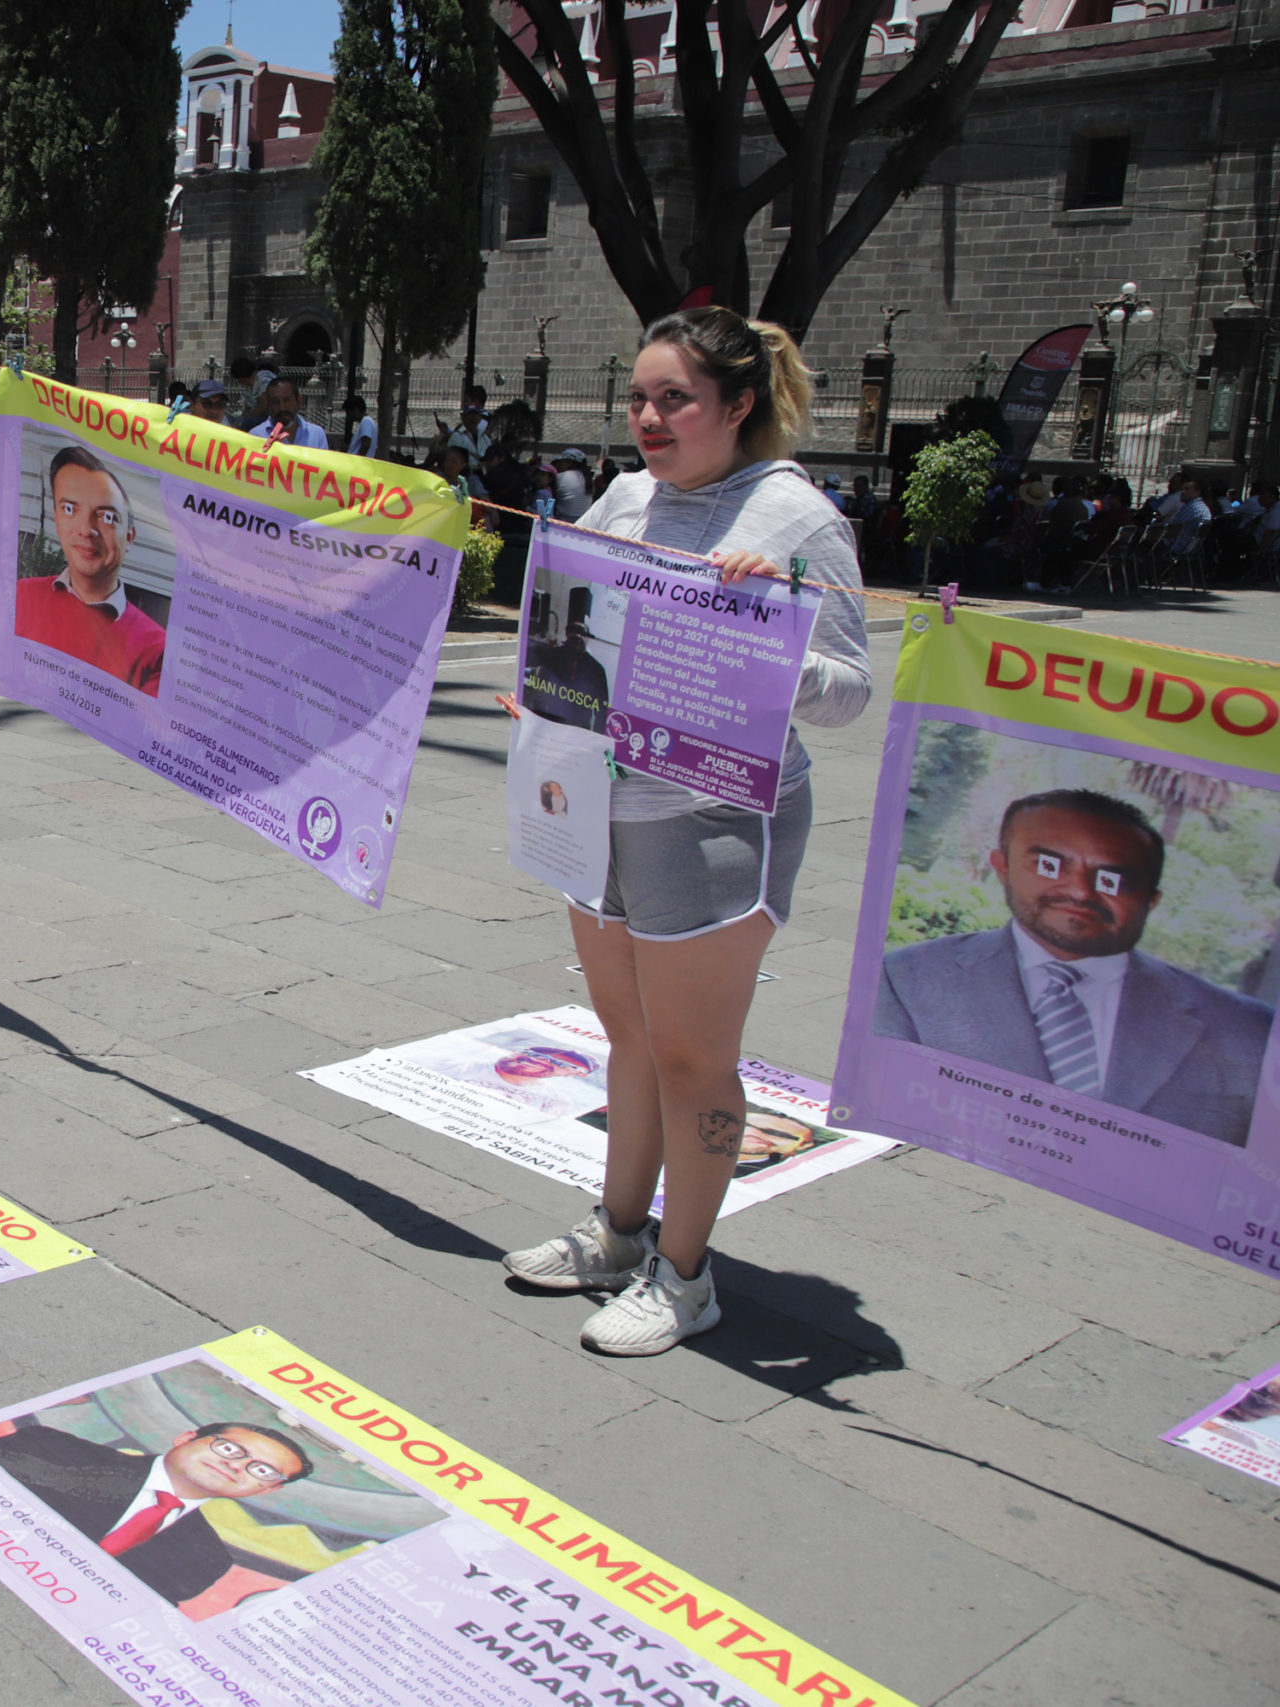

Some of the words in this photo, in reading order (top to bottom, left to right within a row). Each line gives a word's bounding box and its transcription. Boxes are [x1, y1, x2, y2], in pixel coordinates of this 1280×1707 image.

[32, 378, 149, 451] DEUDOR
[158, 428, 413, 521] ALIMENTARIO
[182, 495, 280, 542] AMADITO
[287, 513, 423, 584] ESPINOZA
[426, 556, 443, 580] J.
[607, 545, 653, 565] DEUDOR
[655, 555, 723, 582] ALIMENTARI
[615, 570, 667, 597] JUAN
[671, 584, 739, 617] COSCA
[635, 630, 660, 648] para
[658, 636, 675, 651] no
[674, 640, 706, 661] pagar
[705, 649, 714, 663] y
[637, 614, 654, 631] En
[652, 619, 683, 640] Mayo
[681, 626, 709, 646] 2021
[708, 633, 735, 654] dejó
[733, 641, 751, 657] de
[749, 644, 792, 666] laborar
[640, 603, 674, 623] Desde
[673, 610, 701, 630] 2020
[699, 618, 716, 634] se
[714, 621, 784, 649] desentendió
[23, 648, 66, 680] Número
[67, 667, 80, 681] de
[632, 655, 642, 666] la
[642, 657, 673, 677] orden
[672, 665, 692, 682] del
[690, 671, 718, 690] Juez
[633, 641, 717, 675] desobedeciendo
[58, 684, 101, 716] 924/2018
[559, 686, 599, 712] COSCA
[625, 692, 664, 715] ingreso
[664, 704, 674, 716] al
[629, 667, 658, 685] Tiene
[657, 676, 679, 692] una
[677, 681, 711, 701] orden
[709, 690, 736, 709] ante
[734, 699, 749, 713] la
[668, 692, 683, 707] se
[682, 695, 733, 721] solicitará
[731, 711, 749, 727] su
[168, 717, 216, 750] DEUDORES
[218, 745, 281, 787] ALIMENTARIOS
[202, 750, 236, 774] PUEBLA
[138, 748, 158, 765] QUE
[155, 756, 174, 775] LOS
[174, 771, 215, 803] ALCANCE
[213, 792, 229, 809] LA
[229, 798, 289, 843] VERGÜENZA
[151, 738, 160, 751] SI
[159, 745, 171, 758] LA
[173, 751, 208, 778] JUSTICIA
[210, 773, 224, 789] NO
[224, 782, 244, 801] LOS
[242, 788, 285, 822] ALCANZA
[937, 1066, 1014, 1098] Número
[1020, 1093, 1044, 1108] de
[1050, 1102, 1167, 1151] expediente:
[1005, 1112, 1088, 1146] 10359/2022
[443, 1125, 490, 1142] #LEY
[488, 1140, 555, 1170] SABINA
[1008, 1136, 1074, 1164] 631/2022
[272, 1364, 479, 1486] DEUDOR
[8, 1508, 40, 1527] de
[34, 1528, 121, 1599] expediente:
[463, 1562, 493, 1580] Y
[490, 1585, 530, 1613] EL
[534, 1578, 581, 1612] LA
[589, 1613, 665, 1651] LEY
[83, 1636, 121, 1665] QUE
[116, 1665, 146, 1693] LOS
[504, 1621, 591, 1683] UNA
